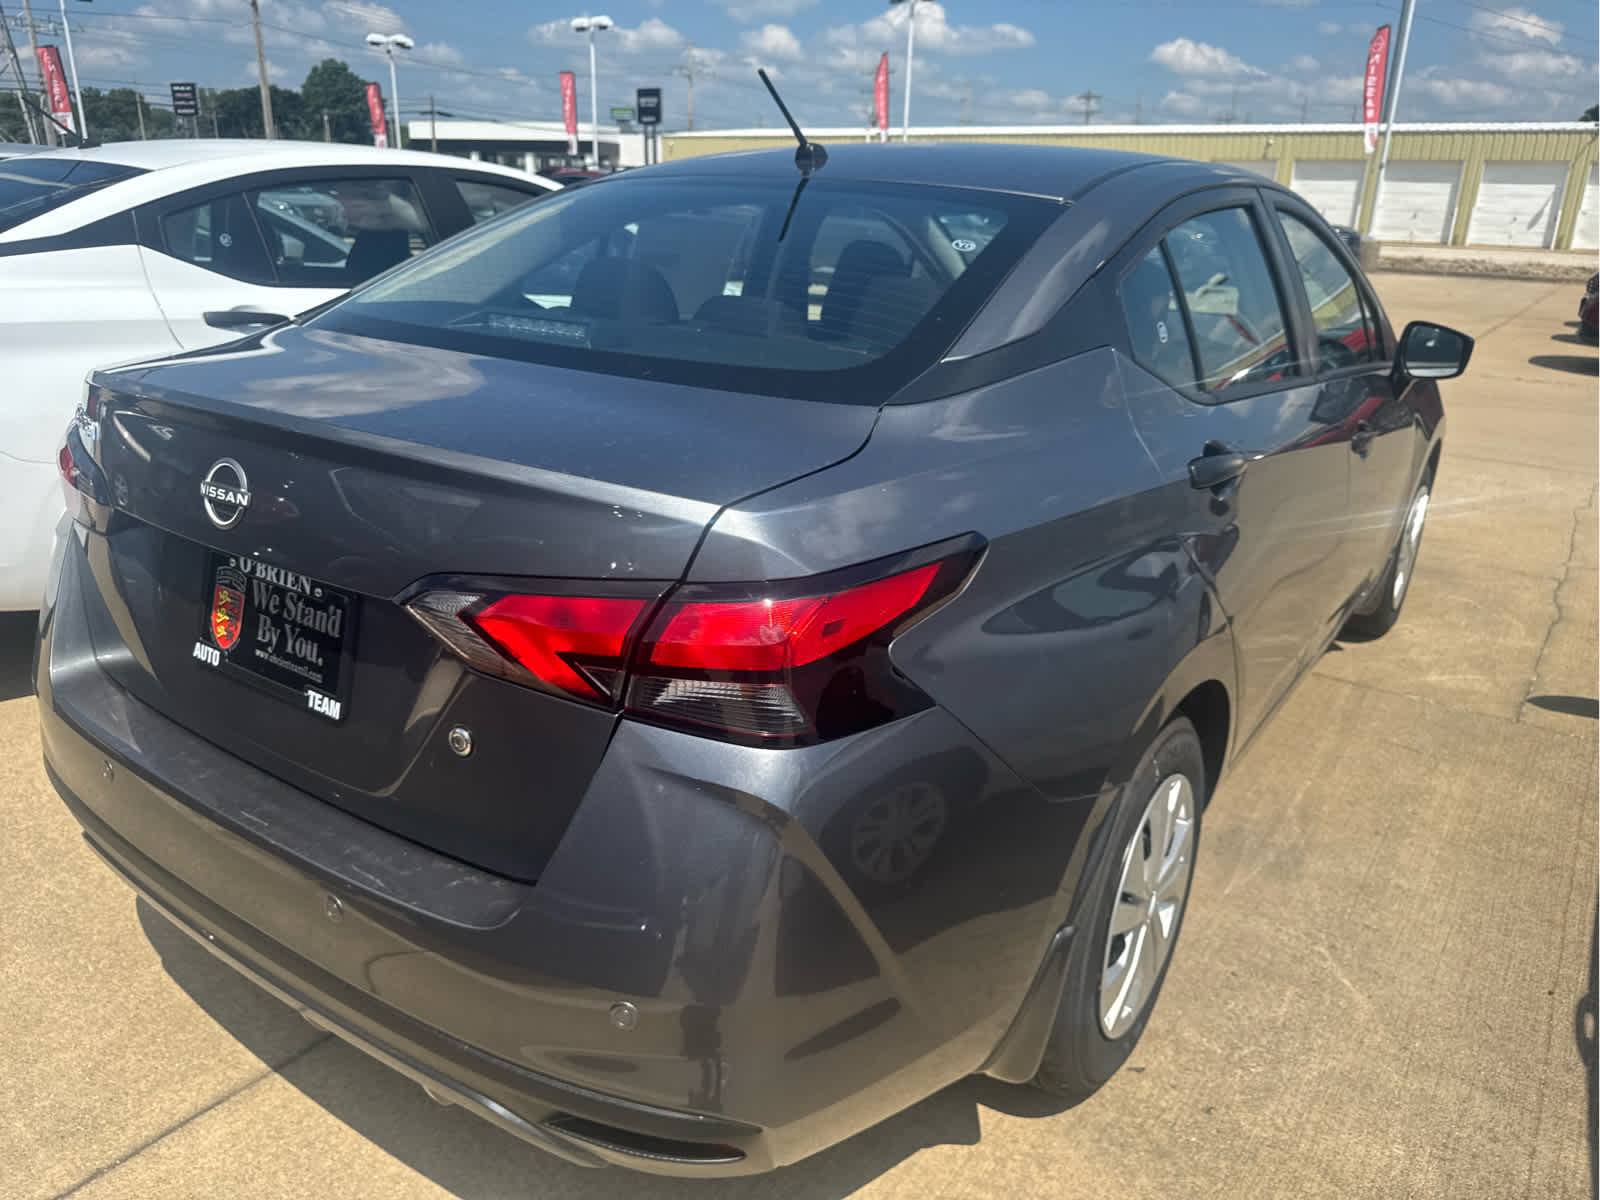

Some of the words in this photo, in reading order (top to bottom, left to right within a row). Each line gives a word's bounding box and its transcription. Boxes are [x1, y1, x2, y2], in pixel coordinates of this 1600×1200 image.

[200, 480, 249, 506] NISSAN
[240, 556, 312, 596] O'BRIEN
[252, 579, 280, 615] We
[283, 591, 342, 639] Stand
[256, 613, 281, 653] By
[284, 624, 324, 668] You.
[193, 641, 221, 667] AUTO
[307, 689, 342, 720] TEAM
